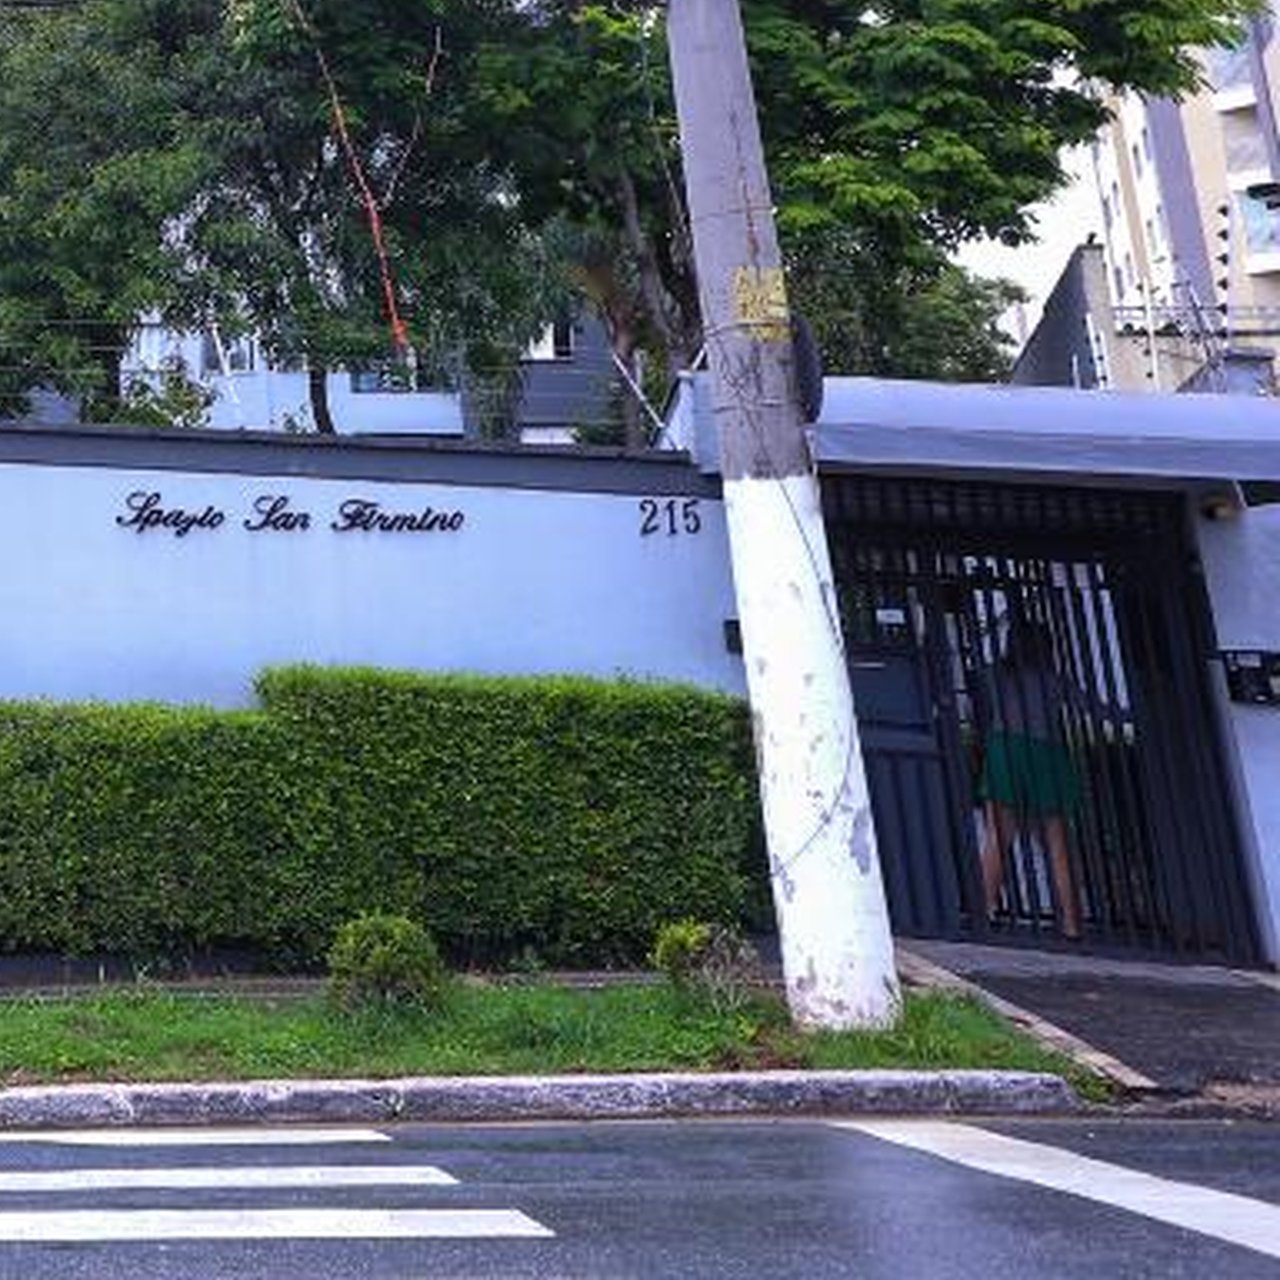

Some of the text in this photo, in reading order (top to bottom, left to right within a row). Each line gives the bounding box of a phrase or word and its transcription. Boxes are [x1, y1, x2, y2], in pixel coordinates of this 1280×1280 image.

[115, 492, 464, 537] Spazio San Firmino
[639, 499, 702, 536] 215
